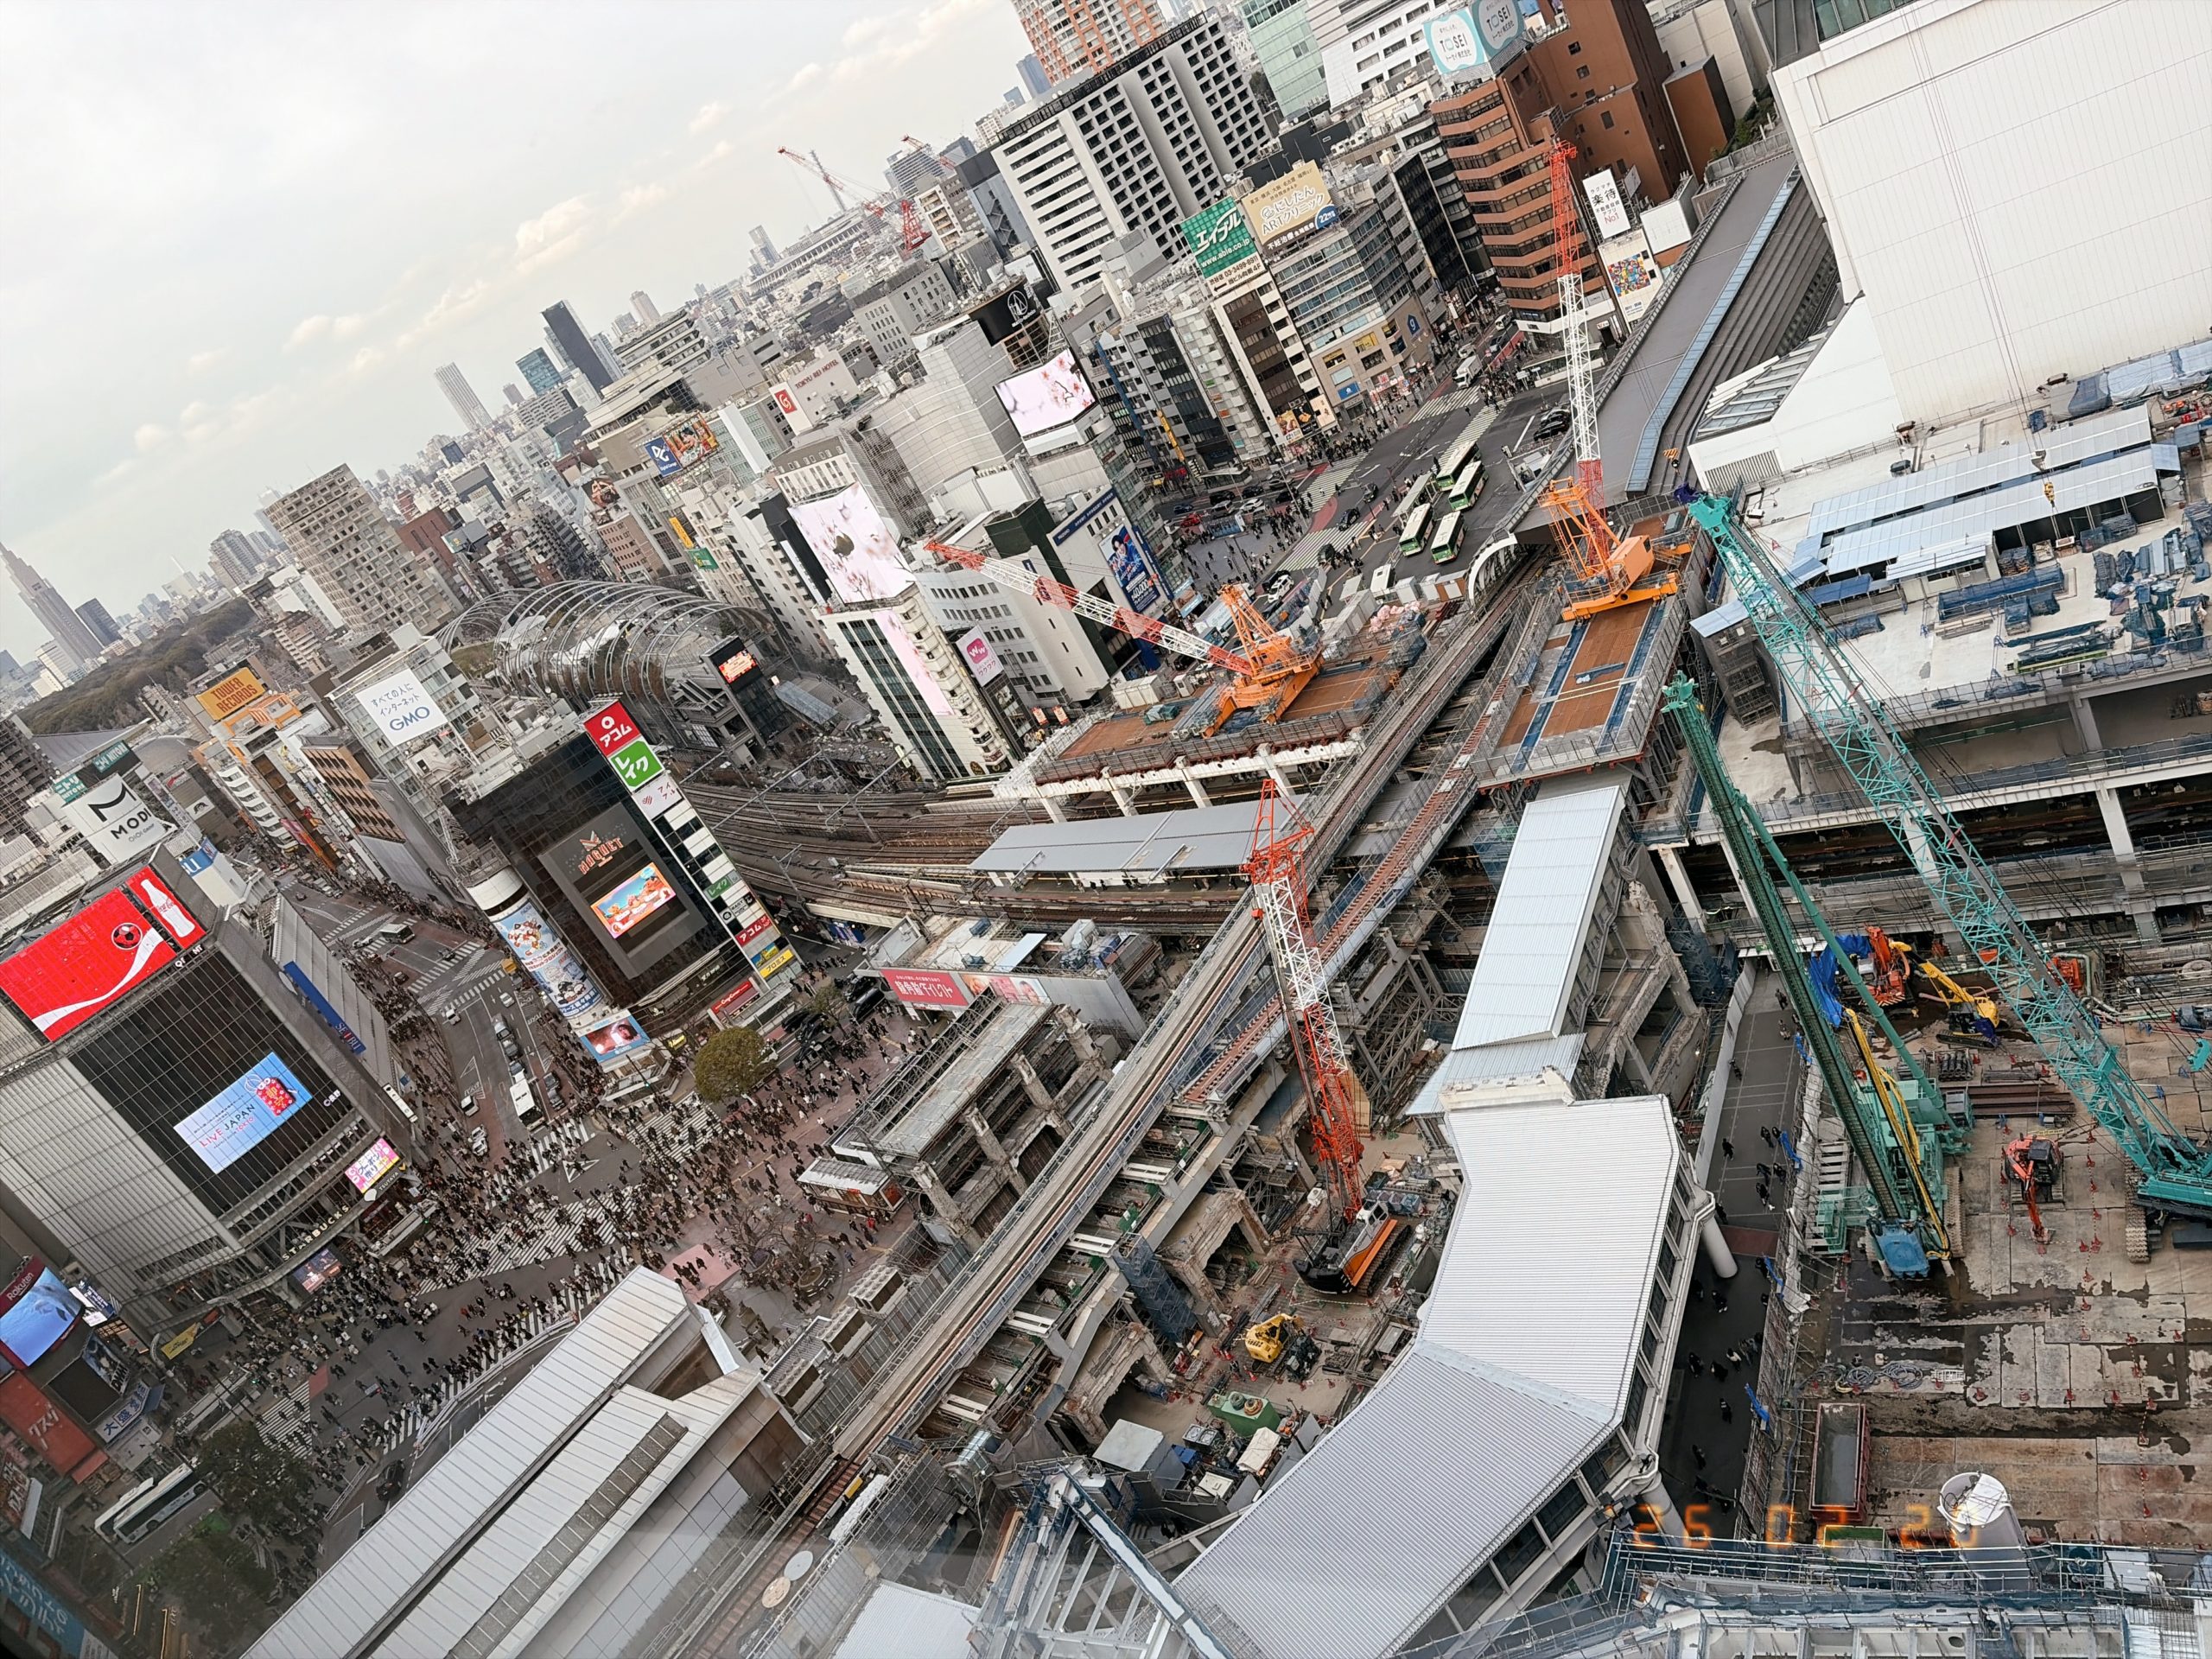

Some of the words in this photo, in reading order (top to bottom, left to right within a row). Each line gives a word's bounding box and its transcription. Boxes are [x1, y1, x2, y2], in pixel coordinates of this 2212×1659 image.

[1274, 186, 1315, 213] にしたん
[1591, 188, 1618, 206] 楽待
[1196, 207, 1242, 247] エイブル
[1262, 193, 1325, 236] ARTクリニック
[1200, 238, 1250, 268] www.able.co.jp
[210, 677, 244, 701] TOWER
[219, 683, 257, 713] RECORDS
[371, 683, 414, 707] すべての人に
[379, 692, 421, 717] インターネット
[390, 705, 431, 732] GMO
[599, 721, 632, 747] アコム
[111, 808, 151, 840] MODI
[740, 923, 762, 942] アコム
[765, 954, 787, 973] プロミス
[200, 1127, 224, 1147] LIVE
[224, 1104, 256, 1129] JAPAN
[378, 1172, 398, 1190] TSUTAYA
[282, 1205, 349, 1261] STARBUCKS
[8, 1272, 34, 1300] Rakuten
